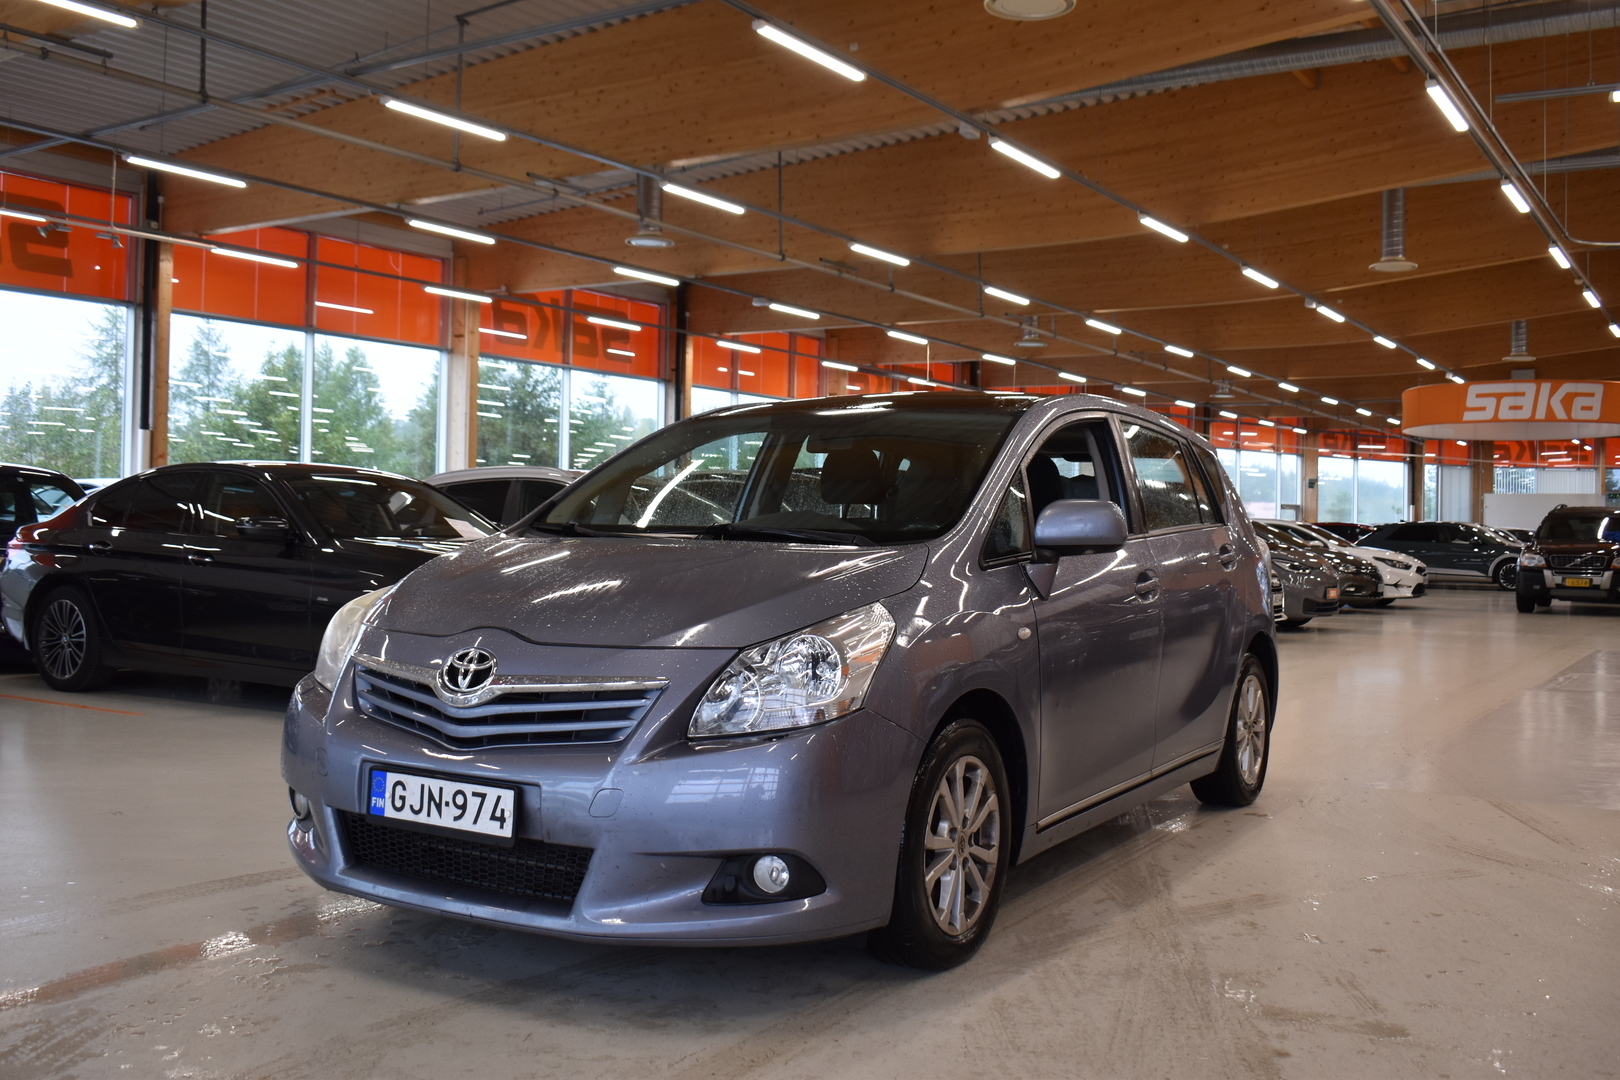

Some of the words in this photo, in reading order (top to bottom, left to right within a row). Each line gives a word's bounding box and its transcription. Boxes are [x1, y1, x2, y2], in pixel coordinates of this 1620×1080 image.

[1463, 382, 1604, 421] saka
[371, 796, 385, 808] FIN
[391, 780, 507, 829] GJN-974
